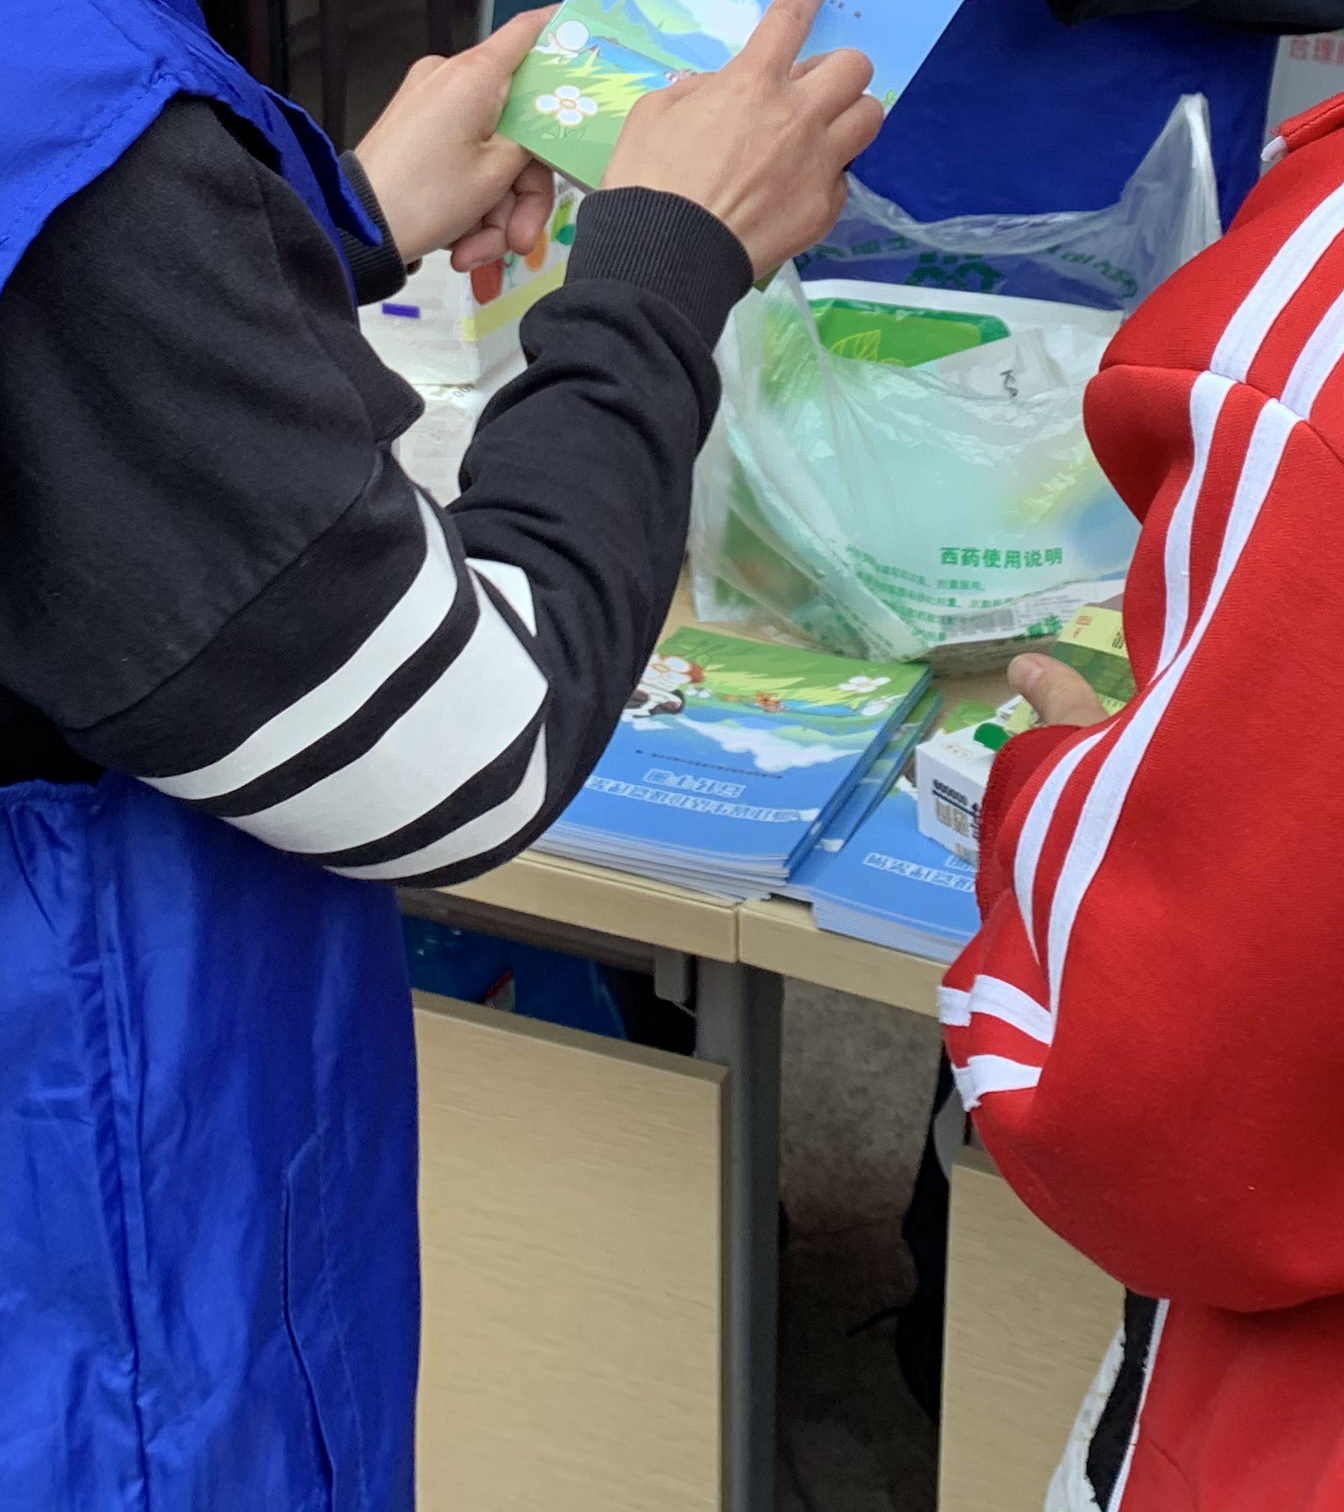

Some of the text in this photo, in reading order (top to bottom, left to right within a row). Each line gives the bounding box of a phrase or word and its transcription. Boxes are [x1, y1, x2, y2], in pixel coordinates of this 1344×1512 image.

[940, 546, 1064, 570] 西药使用说明
